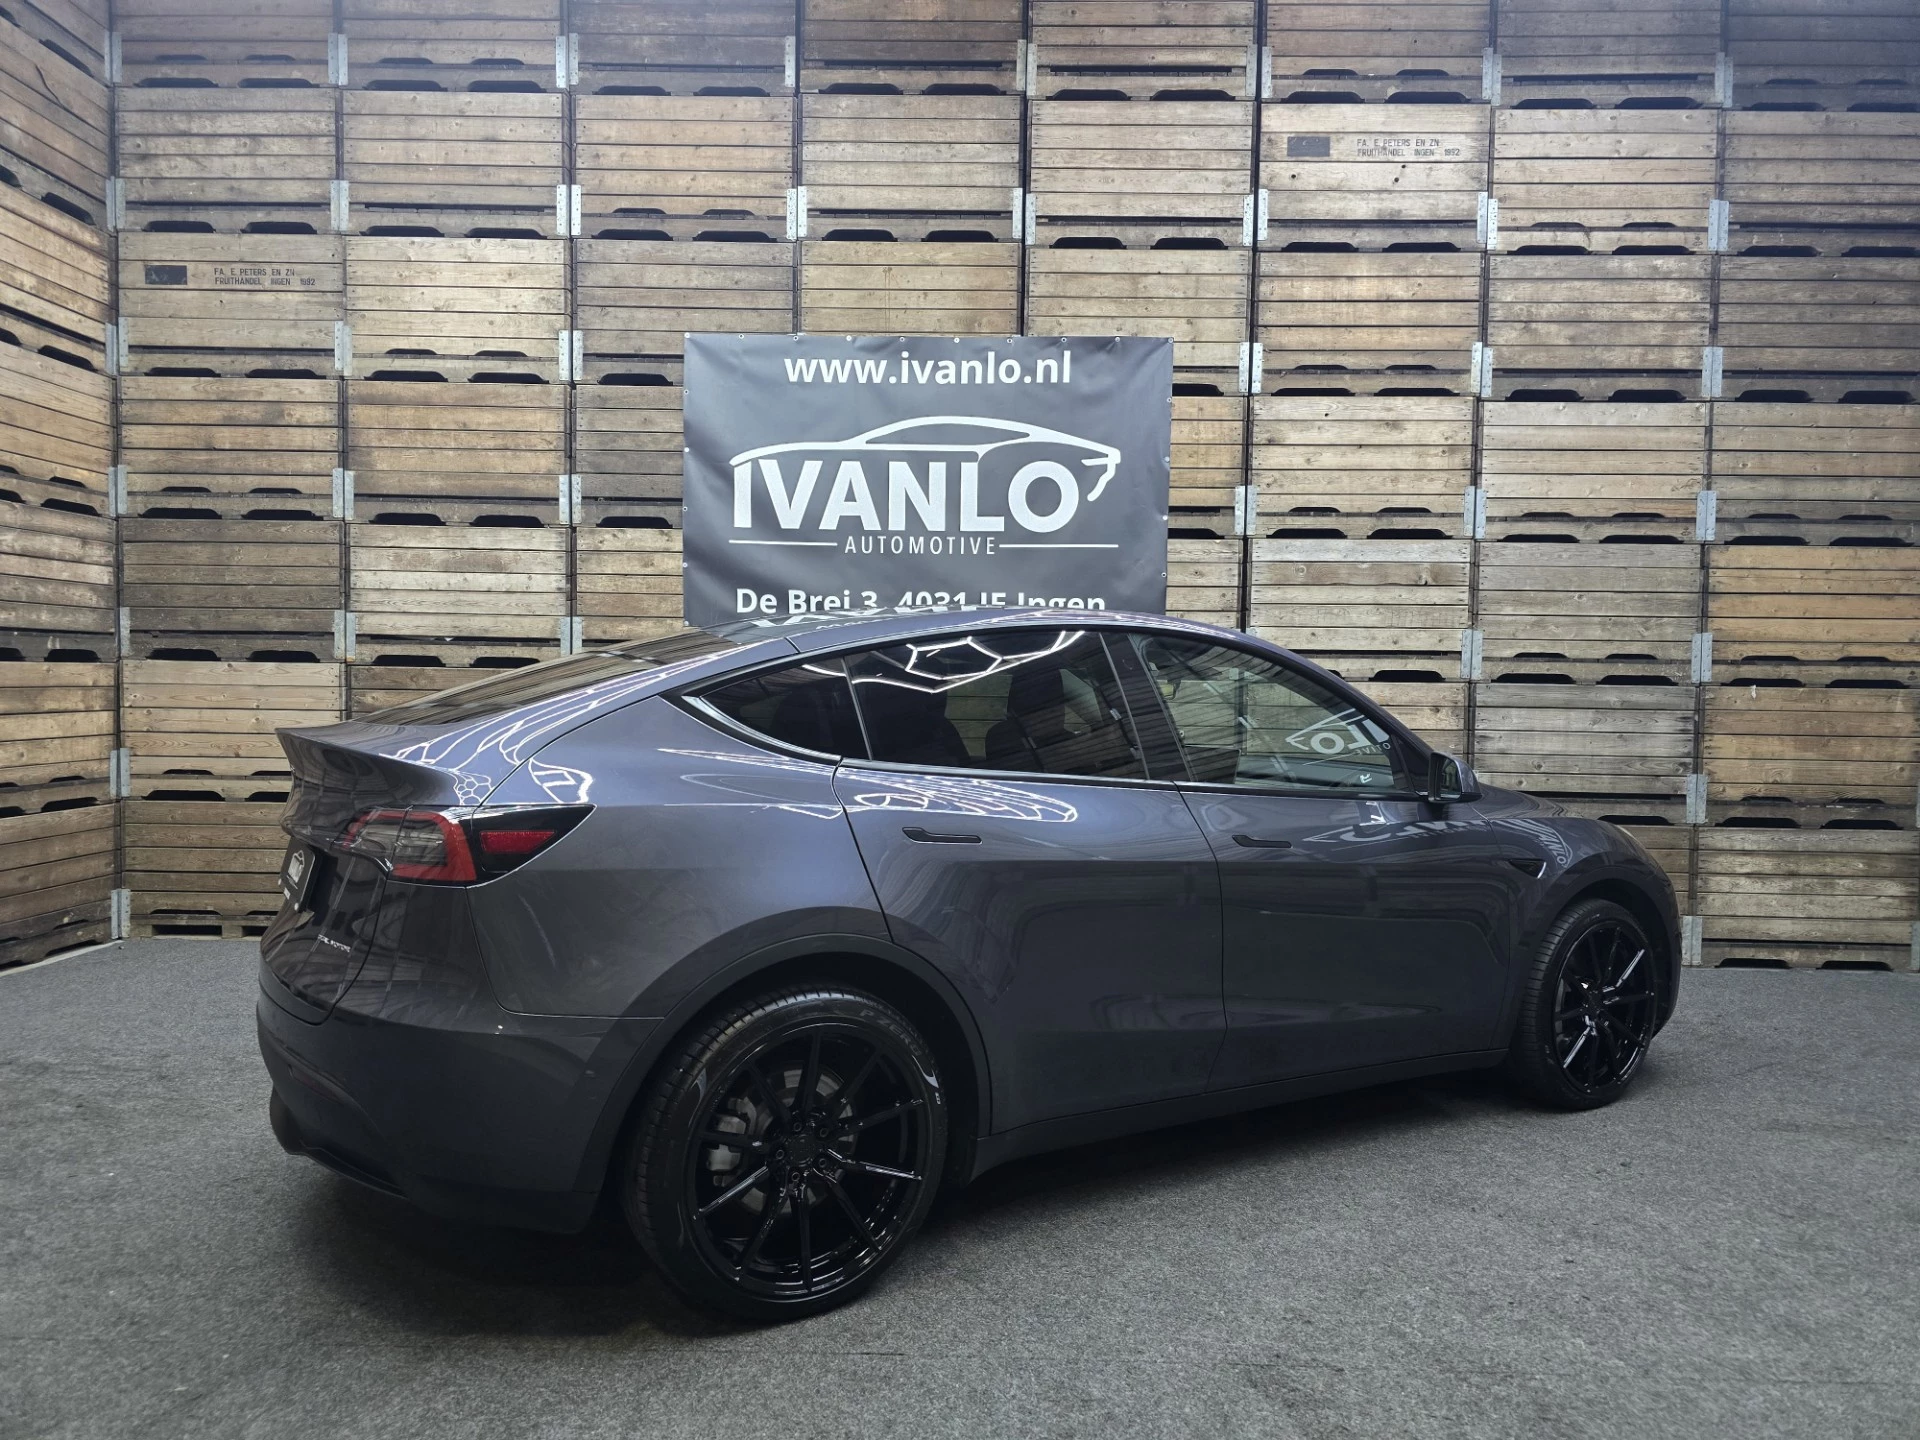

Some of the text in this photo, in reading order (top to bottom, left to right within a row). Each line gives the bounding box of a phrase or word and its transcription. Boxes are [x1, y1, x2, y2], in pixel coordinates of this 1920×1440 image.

[1383, 139, 1411, 147] PETERS
[1416, 139, 1425, 147] EN
[1357, 148, 1405, 157] FRUITHANDEL
[1414, 148, 1434, 157] INGEN
[240, 268, 267, 277] PETERS
[271, 268, 281, 277] EN
[215, 276, 262, 286] FRUITHANDEL
[270, 277, 291, 286] INGEN
[784, 350, 1071, 385] www.ivanlo.nl
[733, 458, 1080, 534] IVANLO
[844, 535, 996, 555] AUTOMOTIVE
[736, 588, 777, 614] De
[788, 588, 850, 614] Brei
